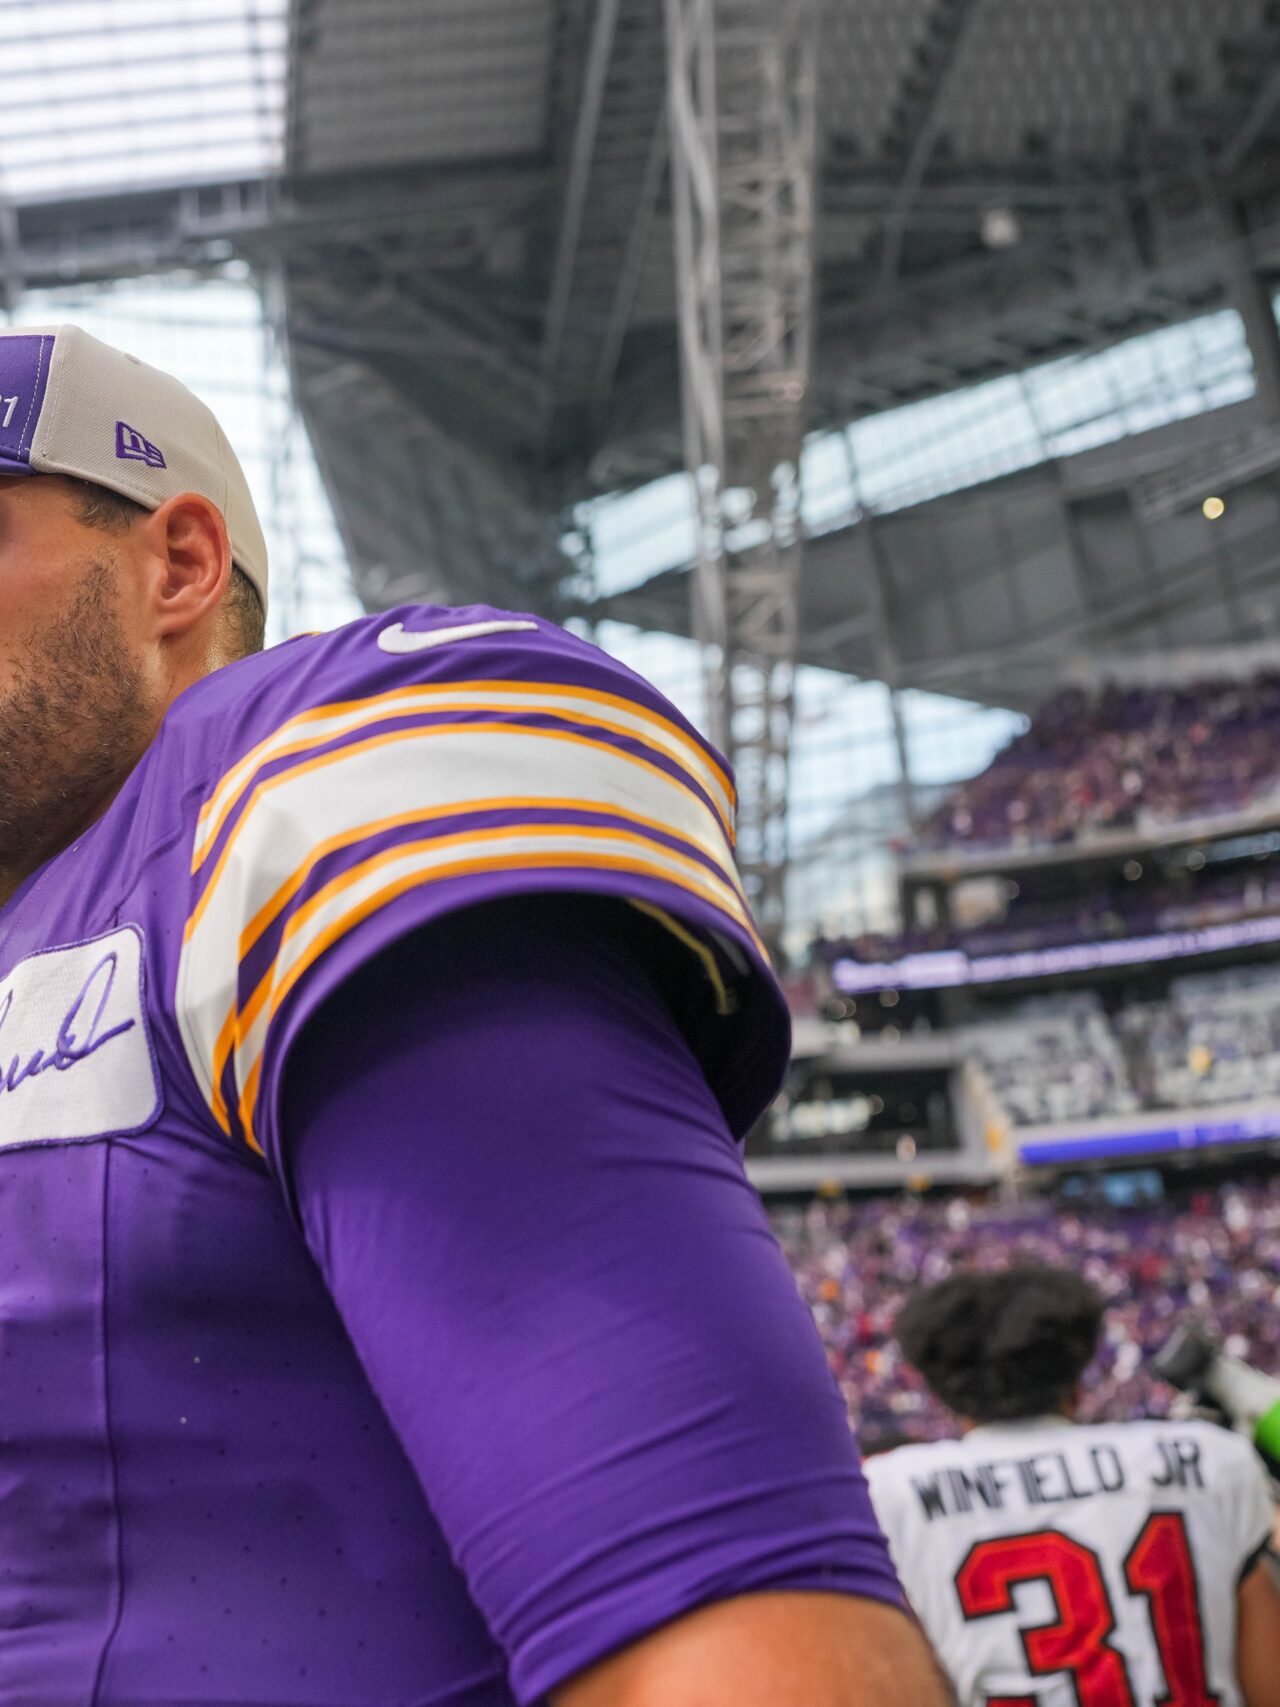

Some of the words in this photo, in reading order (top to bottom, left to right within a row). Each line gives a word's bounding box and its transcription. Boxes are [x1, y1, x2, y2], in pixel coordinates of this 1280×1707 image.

[912, 1445, 1125, 1520] WINFIELD
[1152, 1440, 1205, 1489] JR
[954, 1511, 1225, 1707] 31
